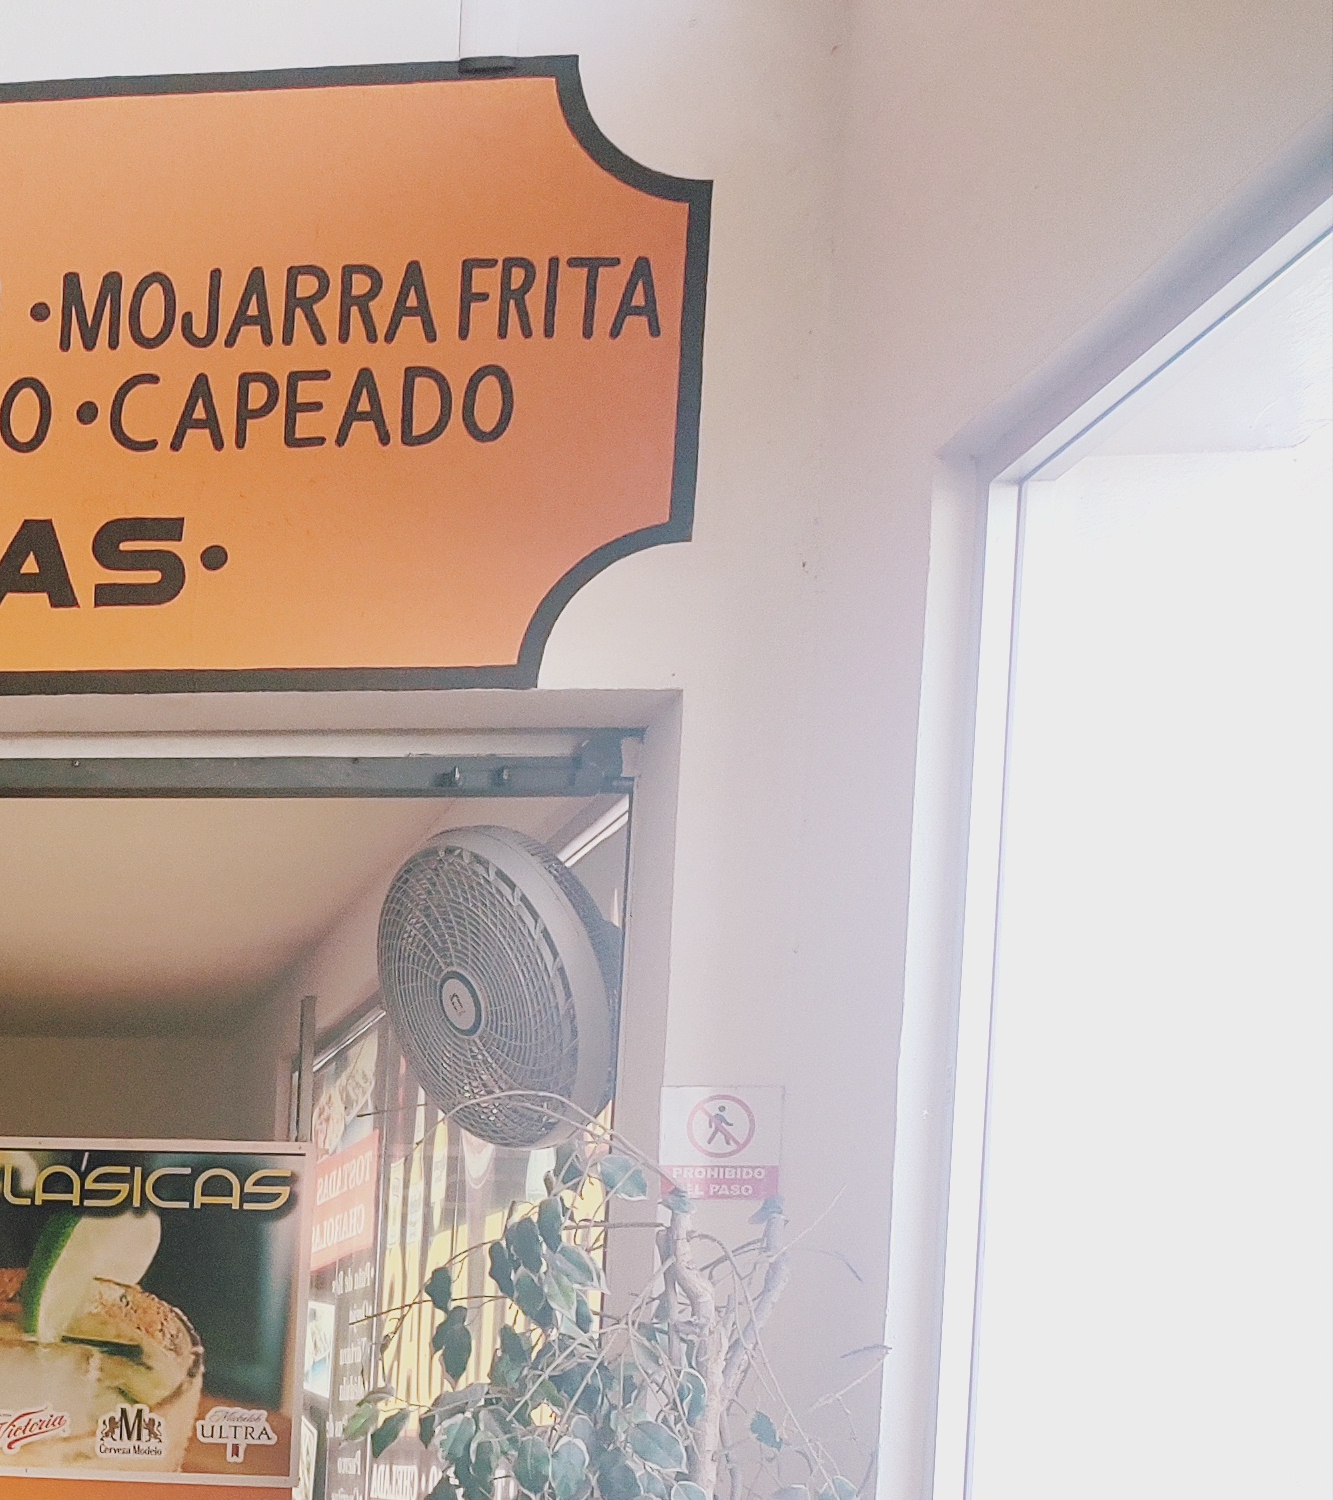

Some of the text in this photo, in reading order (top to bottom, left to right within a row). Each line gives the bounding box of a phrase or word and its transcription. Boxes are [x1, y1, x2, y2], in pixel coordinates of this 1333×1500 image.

[60, 261, 436, 351] MOJARRA
[459, 257, 660, 340] FRITA
[110, 365, 513, 451] CAPEADO
[673, 1167, 766, 1179] PROHIBIDO
[687, 1184, 753, 1196] EL PASO
[201, 1424, 273, 1440] ULTRA
[99, 1446, 162, 1456] Cerveza Modelo
